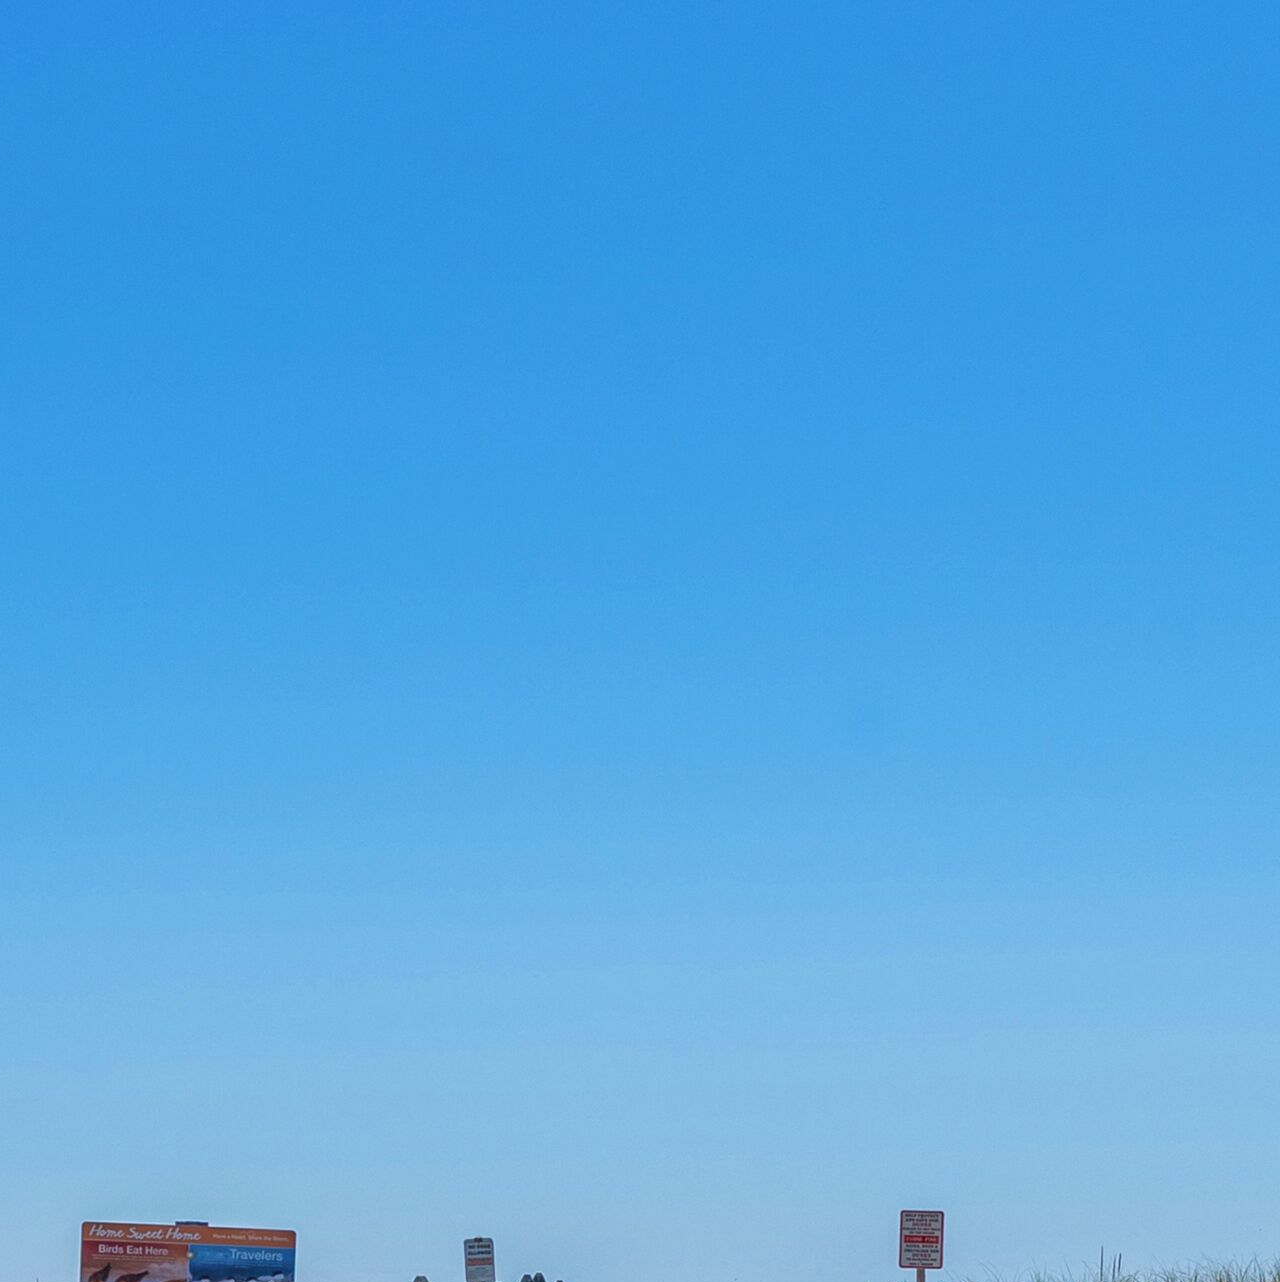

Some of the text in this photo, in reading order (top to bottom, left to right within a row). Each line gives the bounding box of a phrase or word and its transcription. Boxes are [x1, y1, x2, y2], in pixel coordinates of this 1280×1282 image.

[89, 1224, 202, 1241] Home Sweet Home
[98, 1244, 168, 1256] Birds Eat Here
[230, 1248, 284, 1261] Travelers
